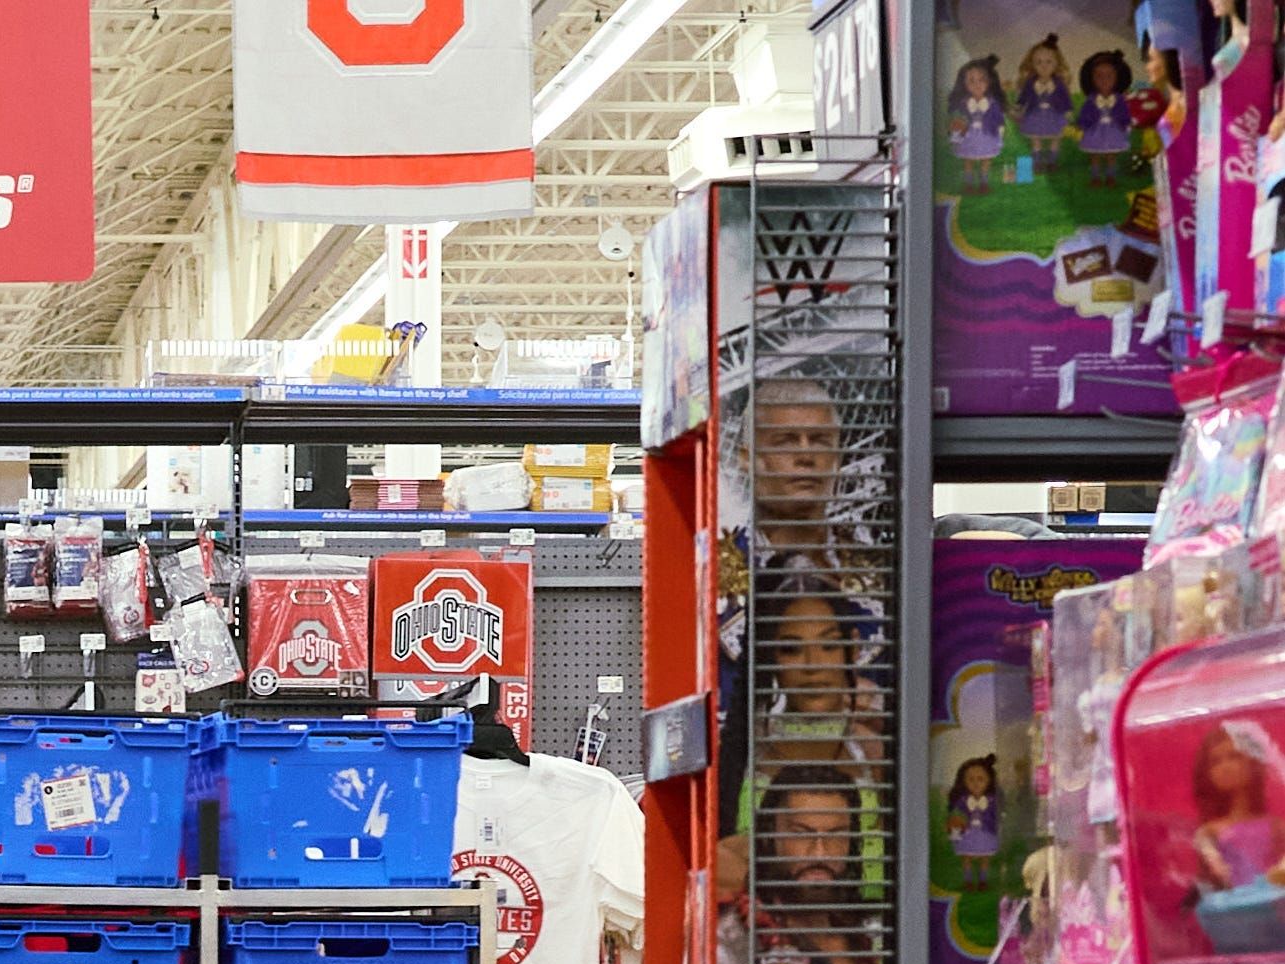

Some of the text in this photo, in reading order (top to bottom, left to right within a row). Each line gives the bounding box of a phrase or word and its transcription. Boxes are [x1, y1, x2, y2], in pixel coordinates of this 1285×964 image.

[286, 386, 301, 395] Ask
[303, 386, 315, 395] for
[317, 387, 358, 396] assistance
[359, 387, 377, 396] with
[379, 389, 401, 397] items
[415, 389, 429, 397] the
[431, 390, 445, 400] top
[393, 596, 501, 662] OHIO STATE
[278, 633, 343, 673] OHIO STATE
[495, 856, 539, 903] UNIVERSITY
